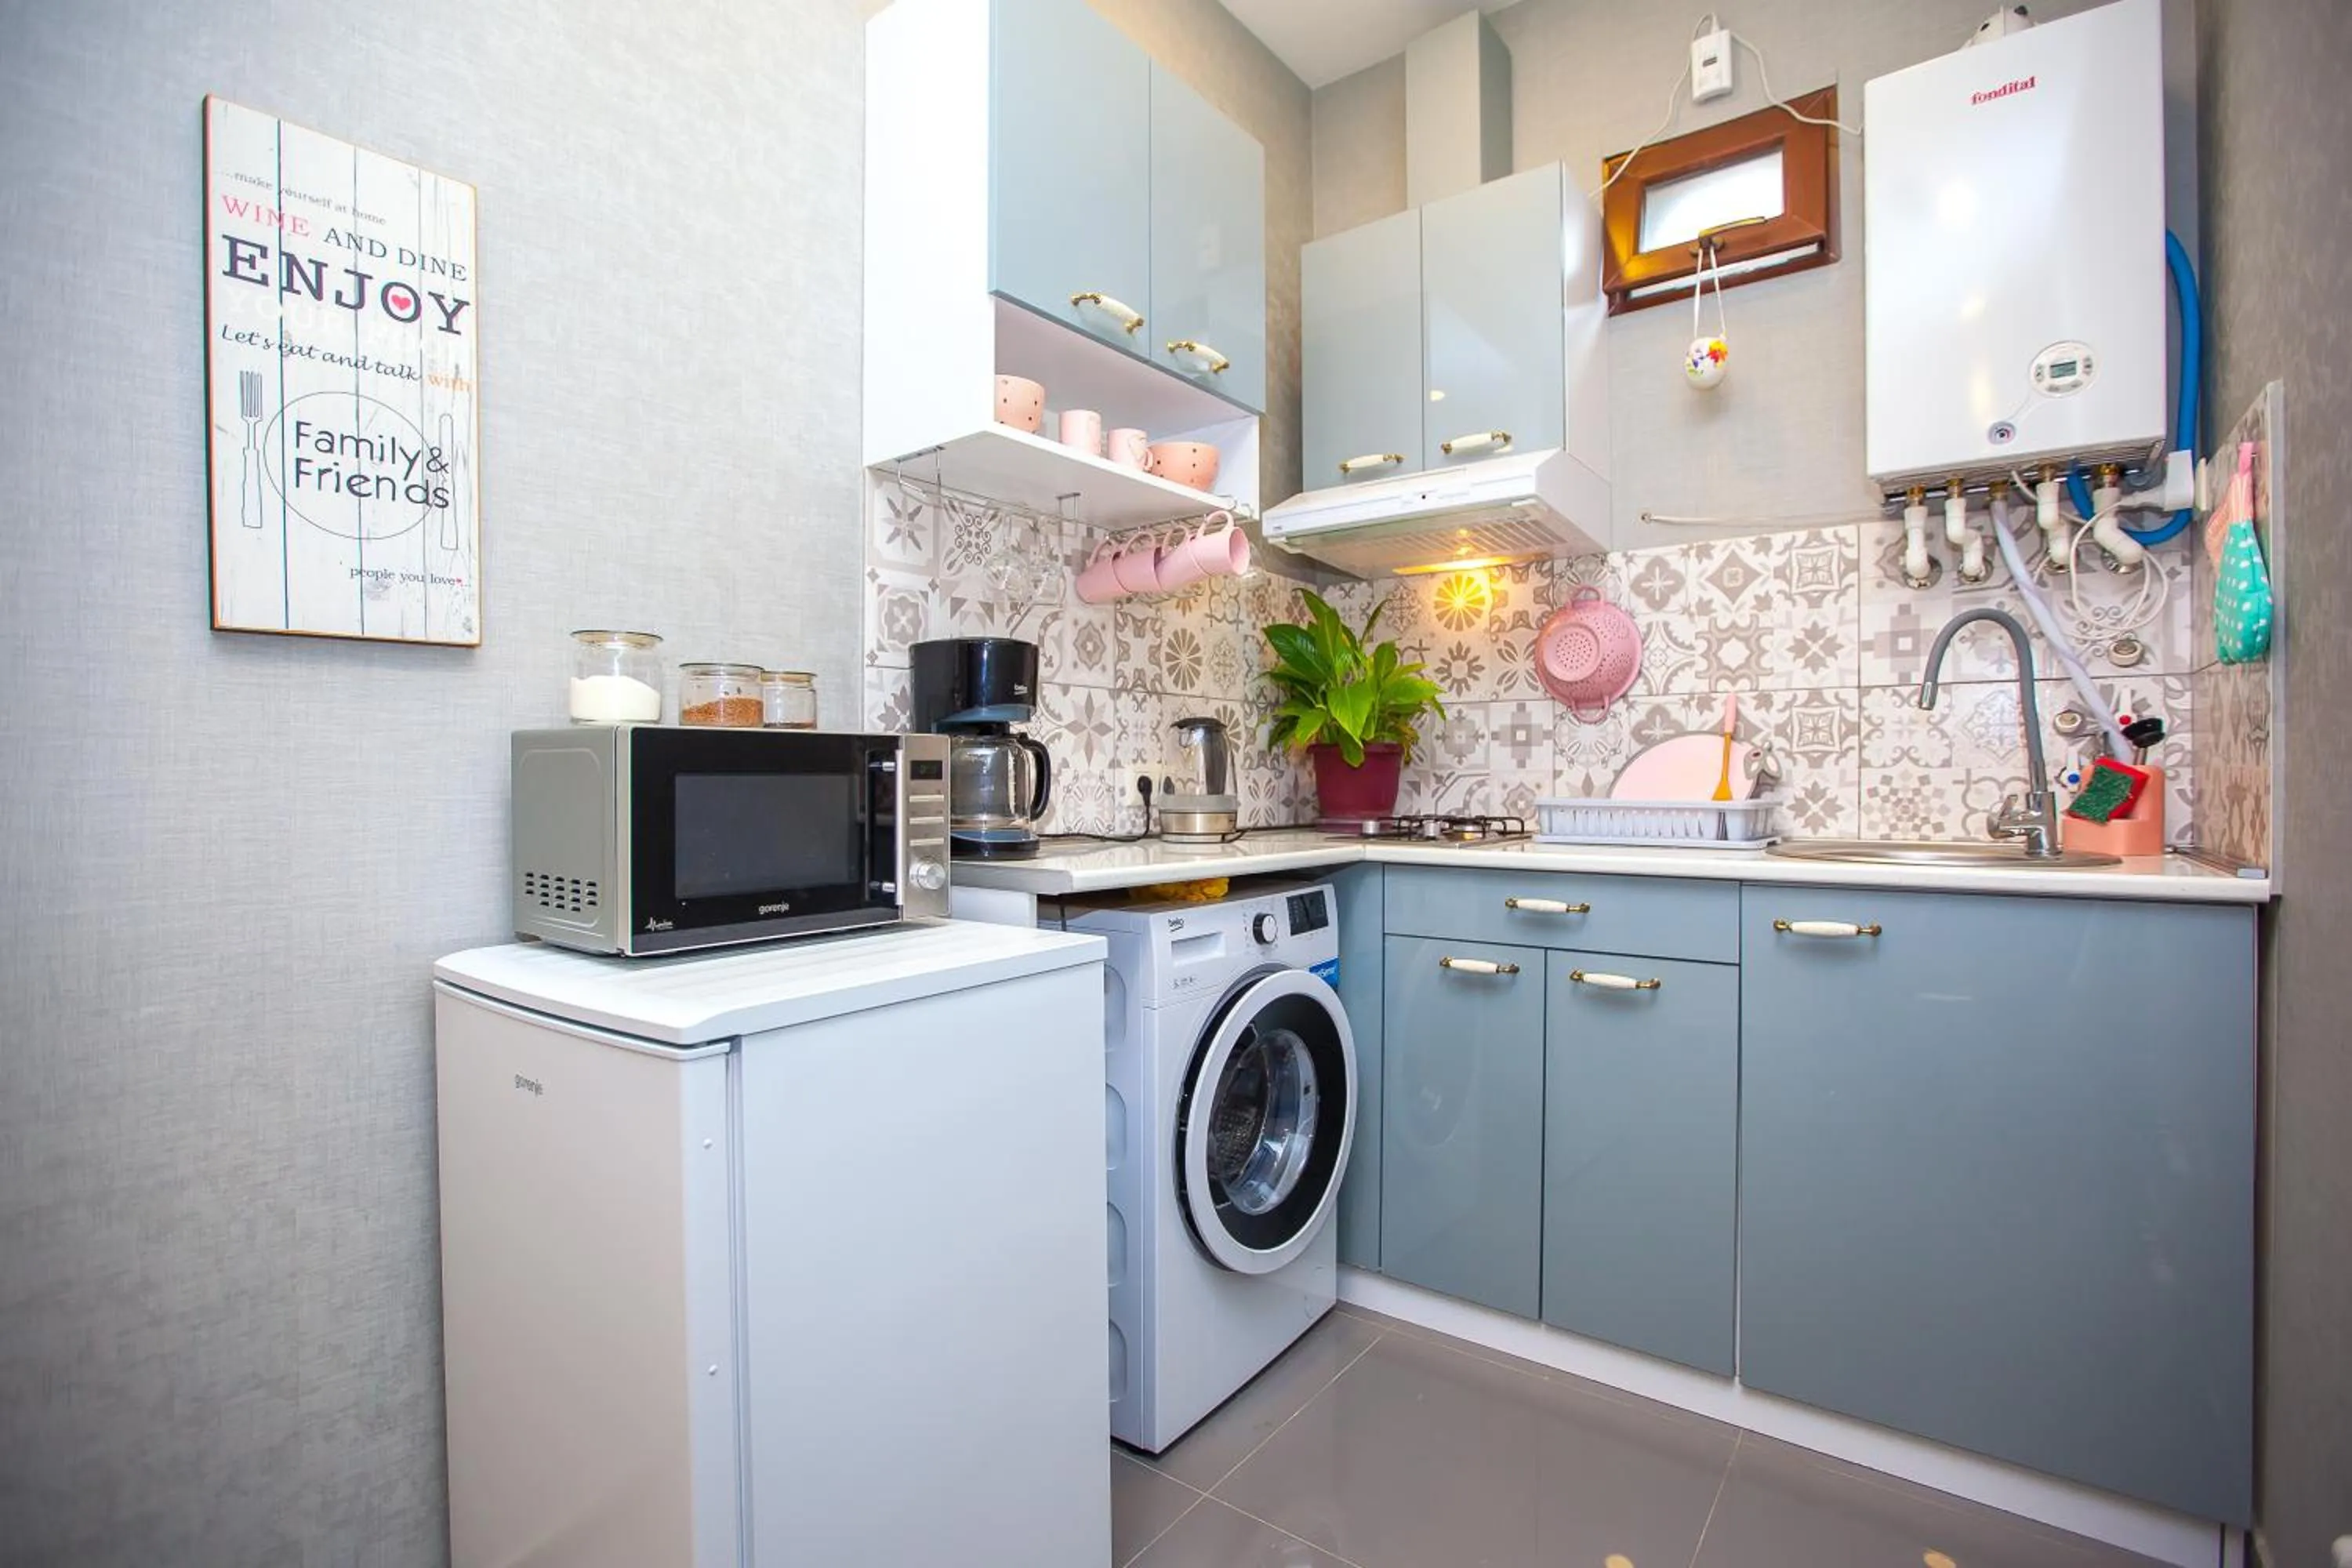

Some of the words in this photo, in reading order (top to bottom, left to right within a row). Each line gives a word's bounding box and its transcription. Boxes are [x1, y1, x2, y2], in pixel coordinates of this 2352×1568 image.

[1971, 75, 2035, 106] fondital
[278, 187, 333, 209] yourself
[335, 204, 347, 213] at
[351, 207, 387, 225] home
[221, 194, 310, 237] WINE
[324, 227, 387, 260] AND
[398, 247, 468, 282] DINE
[221, 234, 470, 336] ENJOY
[222, 323, 274, 350] Let's
[278, 341, 320, 360] eat
[322, 352, 372, 371] and
[375, 361, 422, 381] talk
[295, 420, 422, 481] Family
[426, 446, 449, 474] &
[295, 456, 450, 509] Friends
[350, 568, 396, 581] people
[400, 572, 425, 583] you
[758, 900, 789, 914] gorenje
[514, 1073, 543, 1098] gorenje
